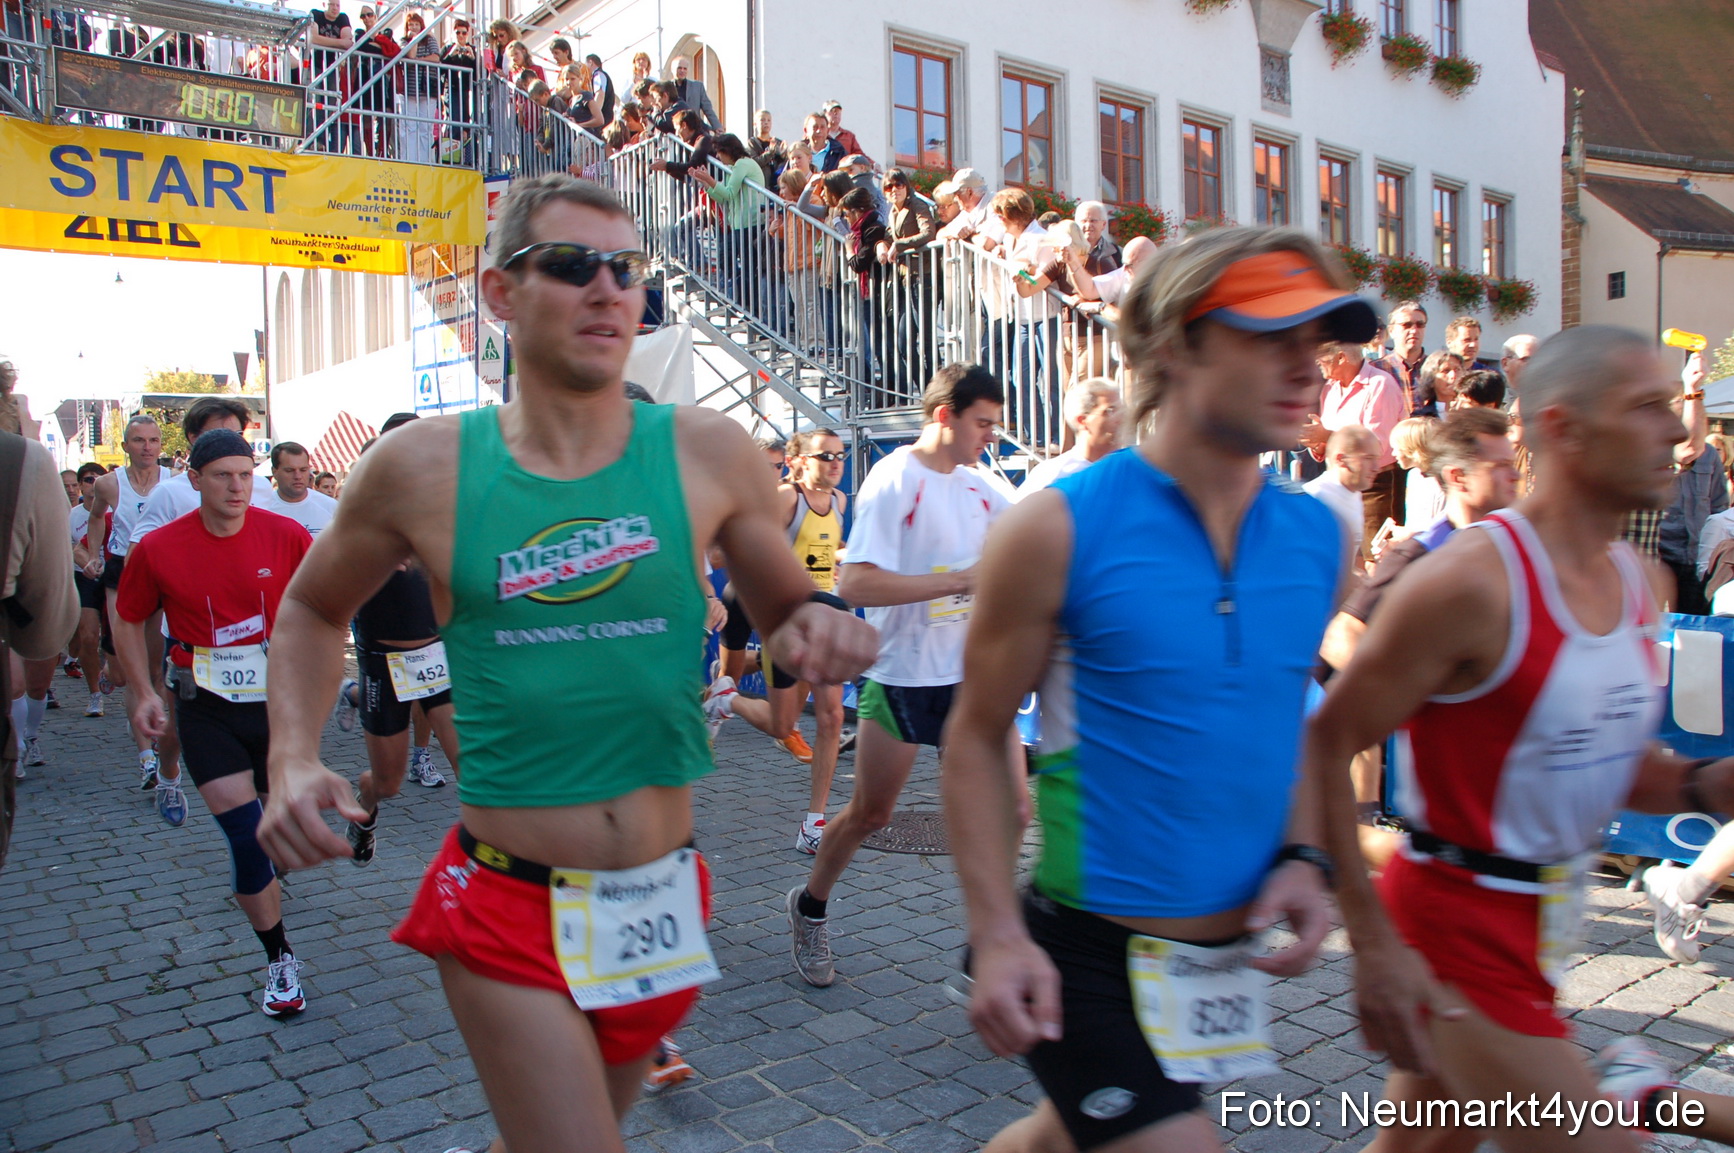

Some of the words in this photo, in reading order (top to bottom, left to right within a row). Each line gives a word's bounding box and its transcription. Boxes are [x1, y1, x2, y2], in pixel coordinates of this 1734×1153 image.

[62, 51, 121, 70] SPORTRONIC
[140, 66, 196, 82] Elektronische
[199, 74, 295, 97] Sportstätteneinrichtungen
[49, 144, 287, 214] START
[326, 199, 397, 215] Neumarkter
[399, 205, 452, 220] Stadtlauf
[270, 236, 332, 249] Neumarkter
[334, 241, 381, 253] Stadtlauf
[503, 572, 554, 595] bike
[583, 537, 658, 570] coffee
[494, 623, 586, 646] RUNNING
[587, 616, 669, 640] CORNER
[221, 669, 257, 686] 302
[416, 664, 447, 683] 452
[616, 912, 680, 962] 290
